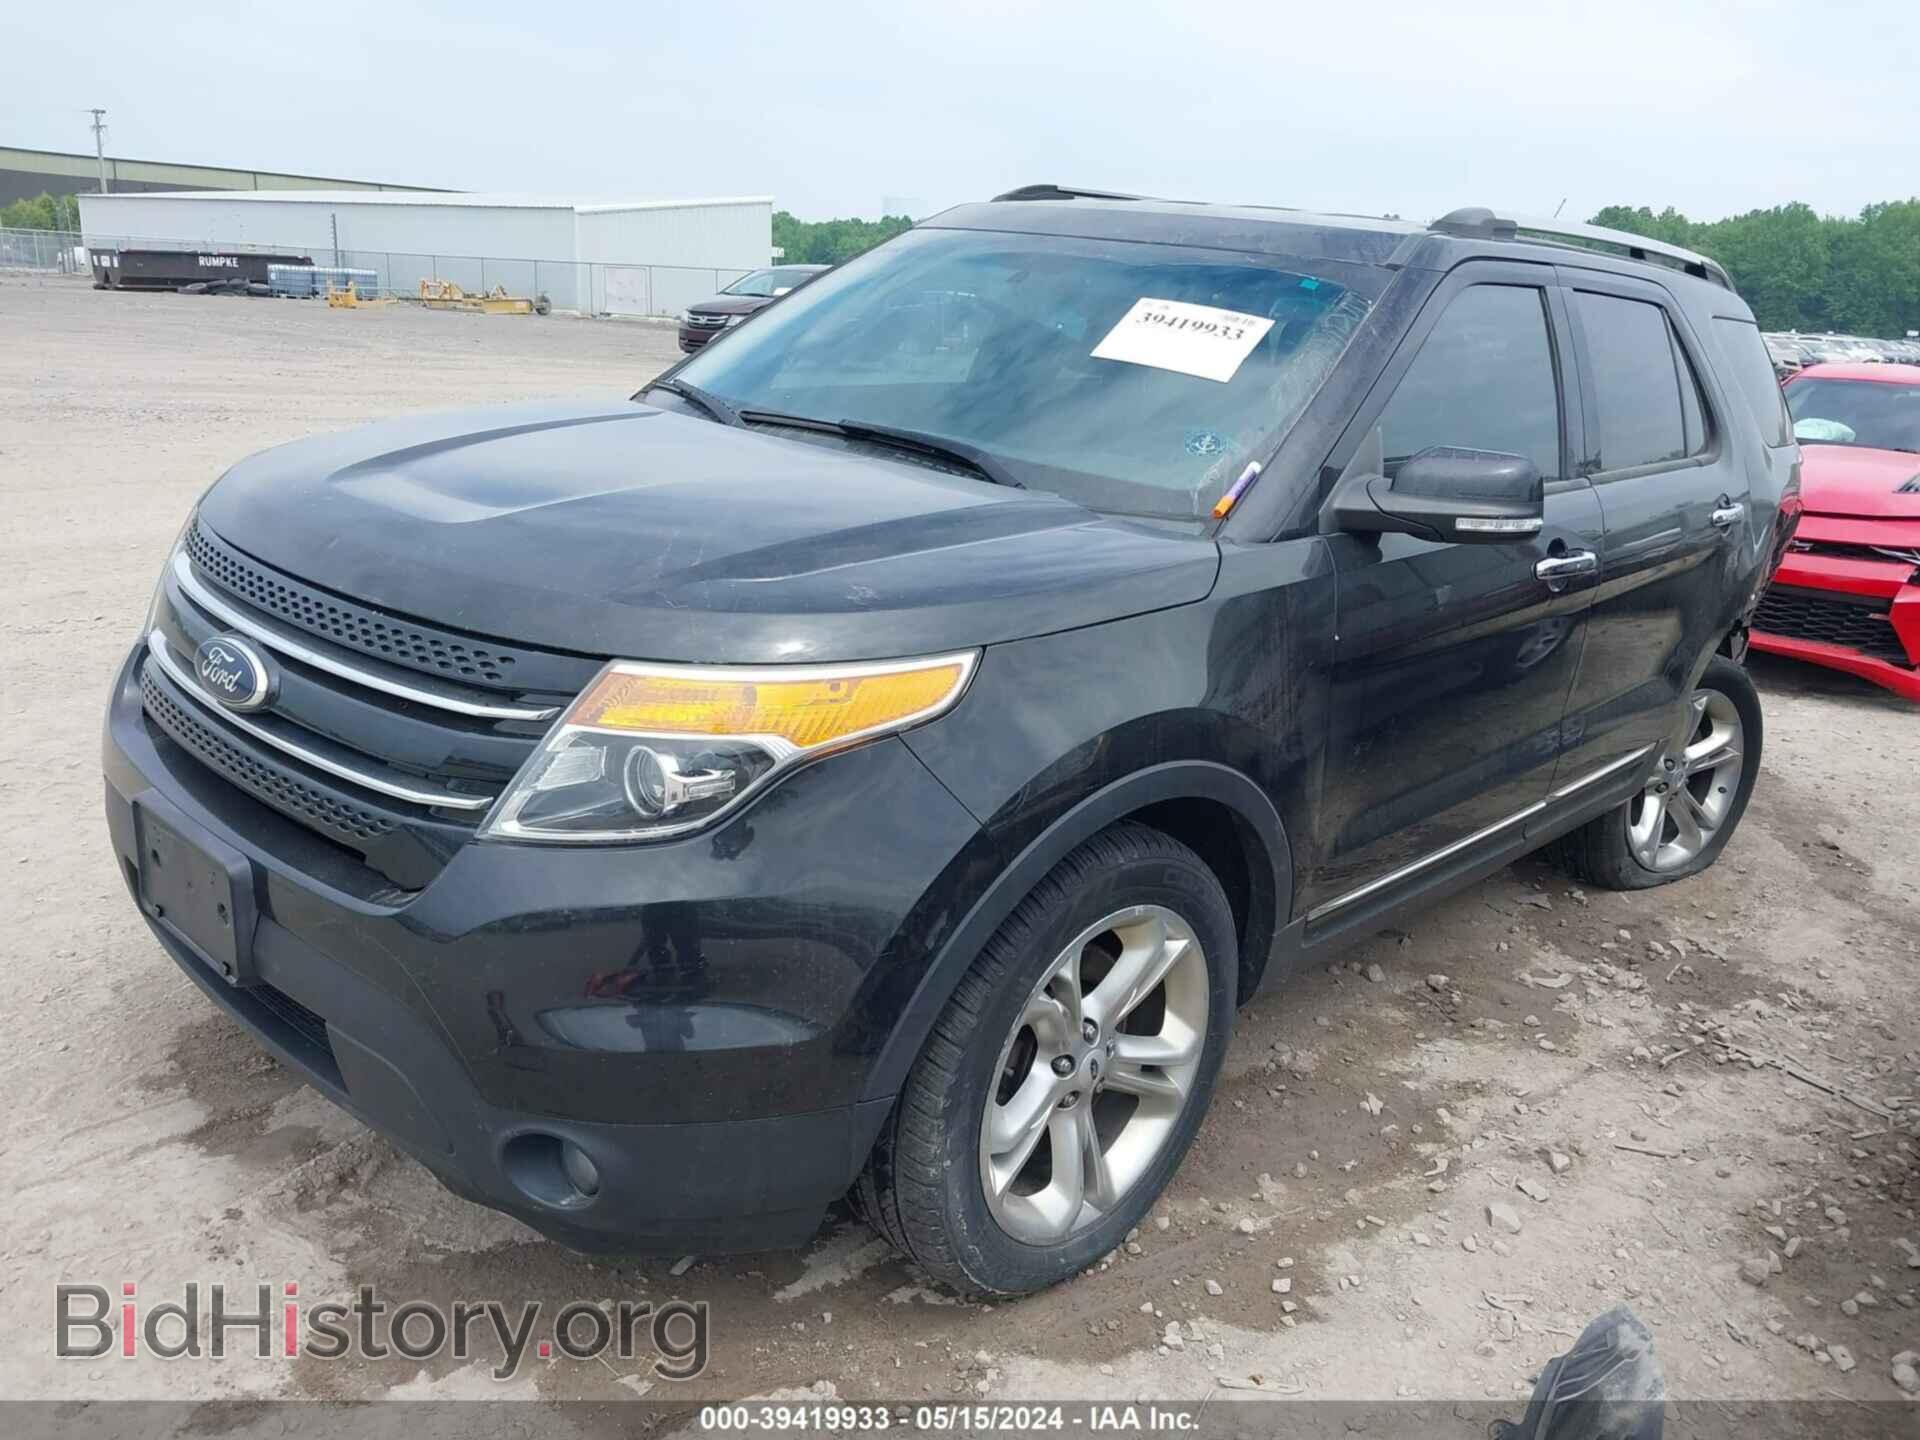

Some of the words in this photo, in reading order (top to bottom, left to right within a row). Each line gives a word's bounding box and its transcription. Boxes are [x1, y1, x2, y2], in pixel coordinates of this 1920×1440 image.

[199, 256, 239, 268] RUMPKE
[1136, 312, 1244, 340] 39419933
[202, 647, 242, 692] Ford
